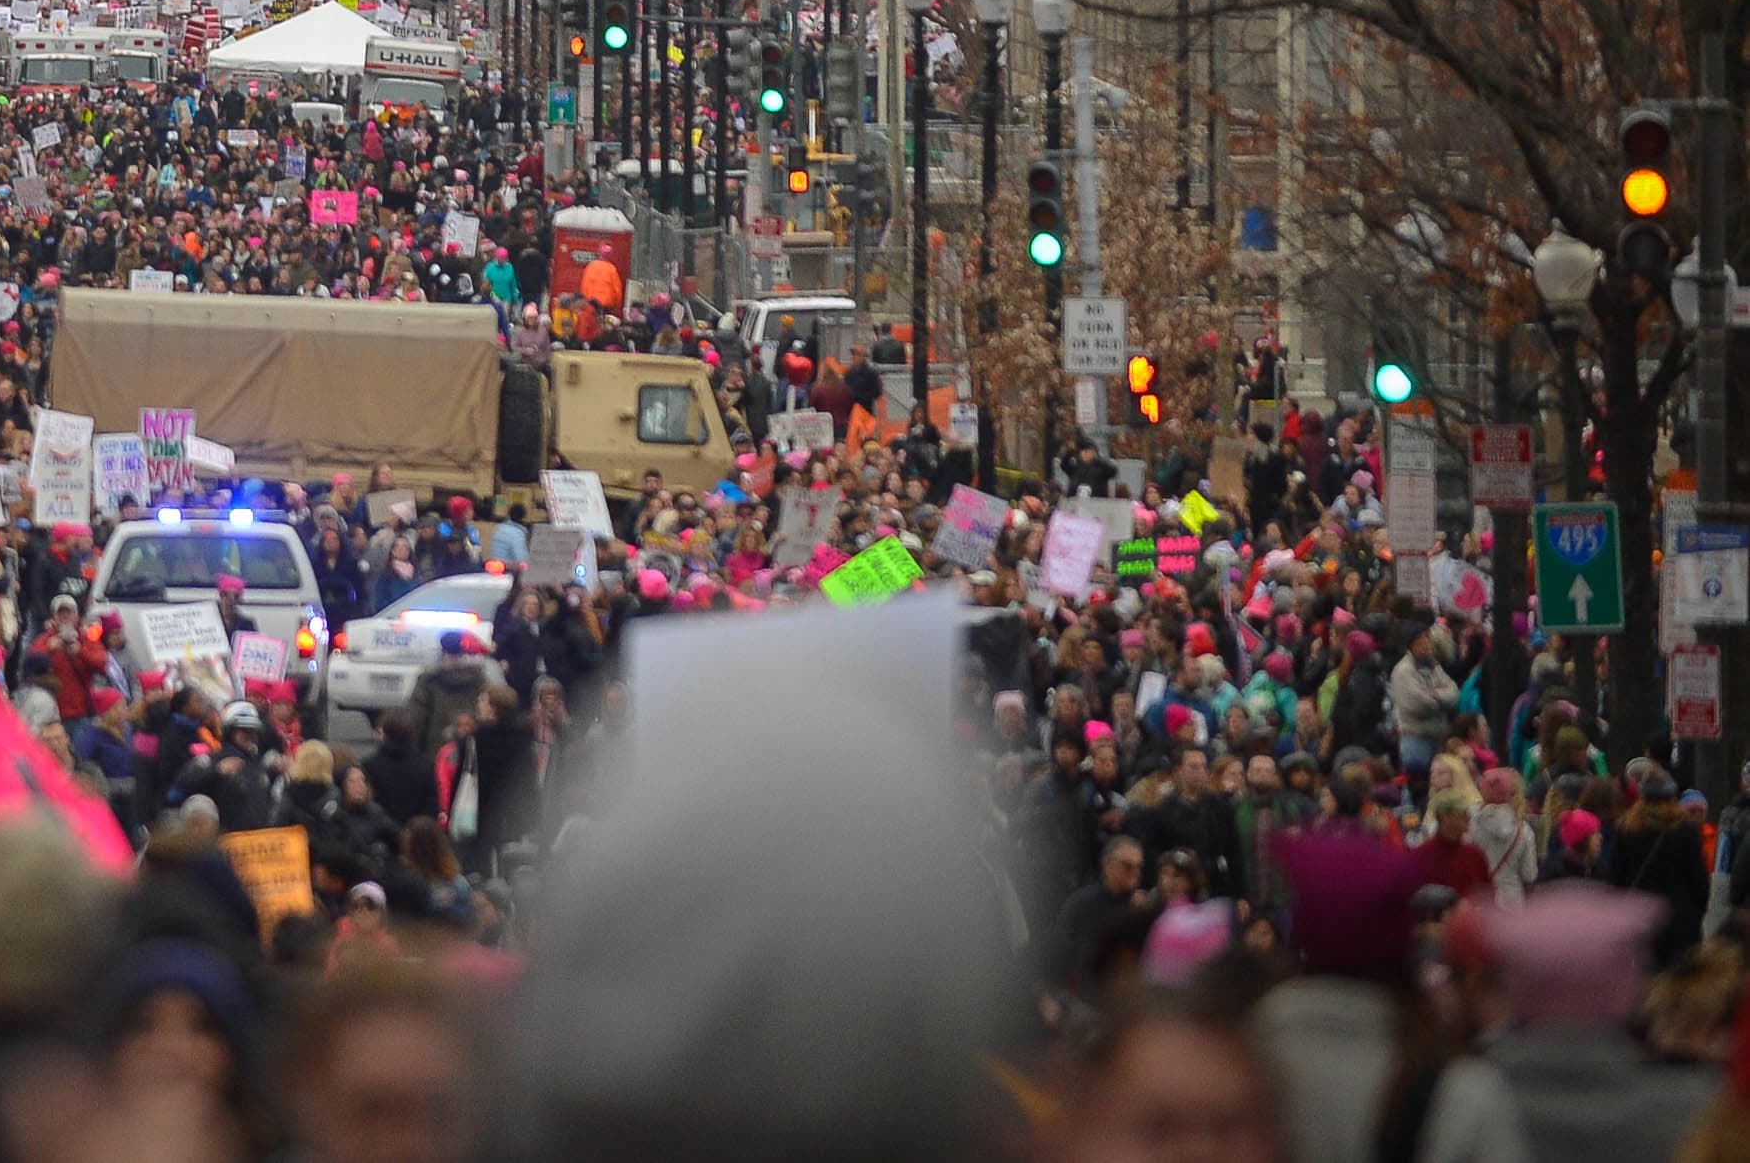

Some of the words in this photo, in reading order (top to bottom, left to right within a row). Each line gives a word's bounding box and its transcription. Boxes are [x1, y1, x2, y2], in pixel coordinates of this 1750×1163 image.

[393, 24, 441, 38] IMPEACH
[380, 50, 447, 68] U-HAUL
[143, 411, 194, 440] NOT
[147, 459, 194, 487] SATAN
[1558, 523, 1599, 553] 495
